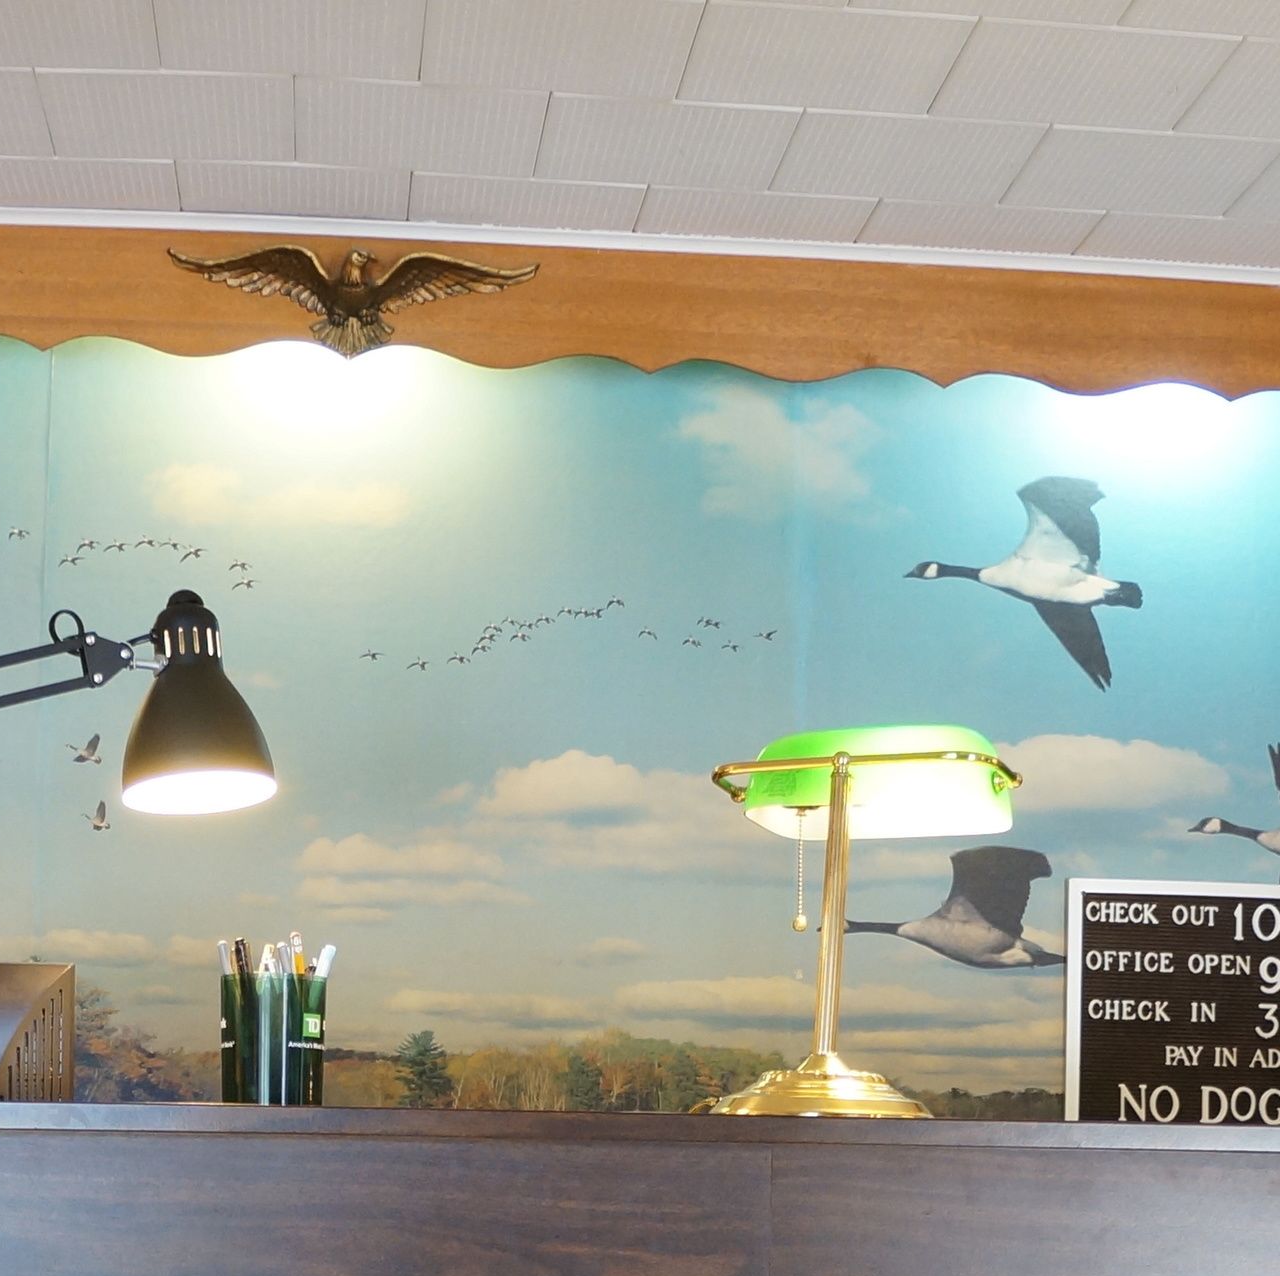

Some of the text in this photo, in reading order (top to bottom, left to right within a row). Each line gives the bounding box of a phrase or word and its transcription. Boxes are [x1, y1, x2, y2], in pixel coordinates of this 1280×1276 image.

[1085, 902, 1159, 925] CHECK
[1172, 905, 1219, 927] OUT
[1086, 950, 1175, 974] OFFICE
[1187, 953, 1252, 975] OPEN
[1087, 999, 1171, 1022] CHECK
[1190, 1002, 1216, 1022] IN
[306, 1018, 320, 1033] TD
[1165, 1045, 1203, 1067] PAY
[1214, 1047, 1237, 1067] IN
[1118, 1084, 1180, 1124] NO
